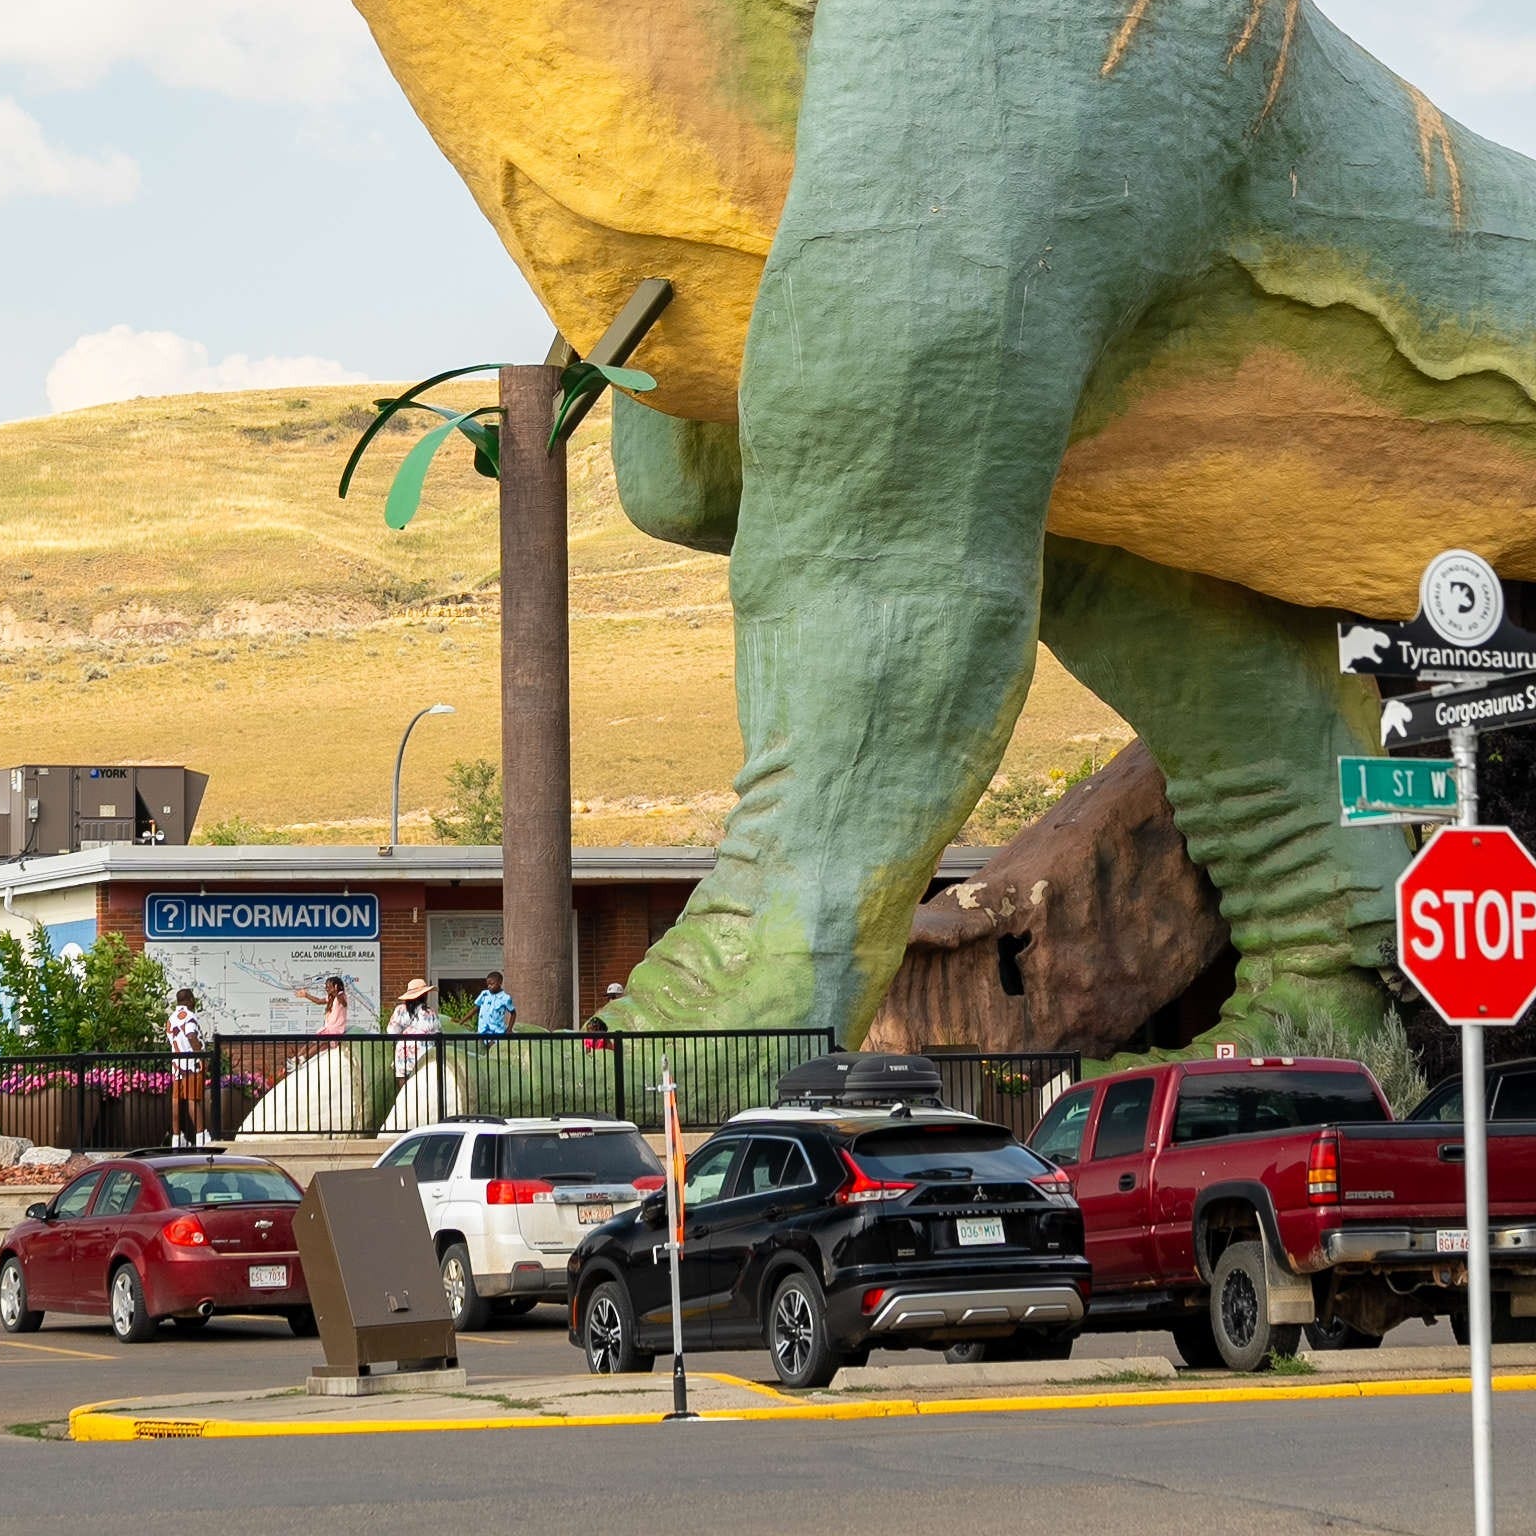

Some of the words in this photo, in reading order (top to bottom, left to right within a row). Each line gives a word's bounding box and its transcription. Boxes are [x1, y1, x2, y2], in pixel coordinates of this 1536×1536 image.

[1435, 694, 1525, 728] Gorgosaurus
[100, 768, 128, 779] YORK
[1358, 764, 1368, 800] 1
[1392, 769, 1415, 797] ST
[1430, 770, 1447, 799] W
[190, 904, 370, 928] INFORMATION
[291, 951, 312, 959] LOCAL
[313, 951, 357, 959] DRUMHELLER
[358, 951, 375, 959] AREA
[1221, 1047, 1230, 1060] P
[585, 1192, 609, 1200] GMC
[1345, 1190, 1395, 1200] SIERRA
[960, 1226, 978, 1239] 036
[984, 1224, 1002, 1238] MVT
[1439, 1238, 1470, 1250] BGV-46
